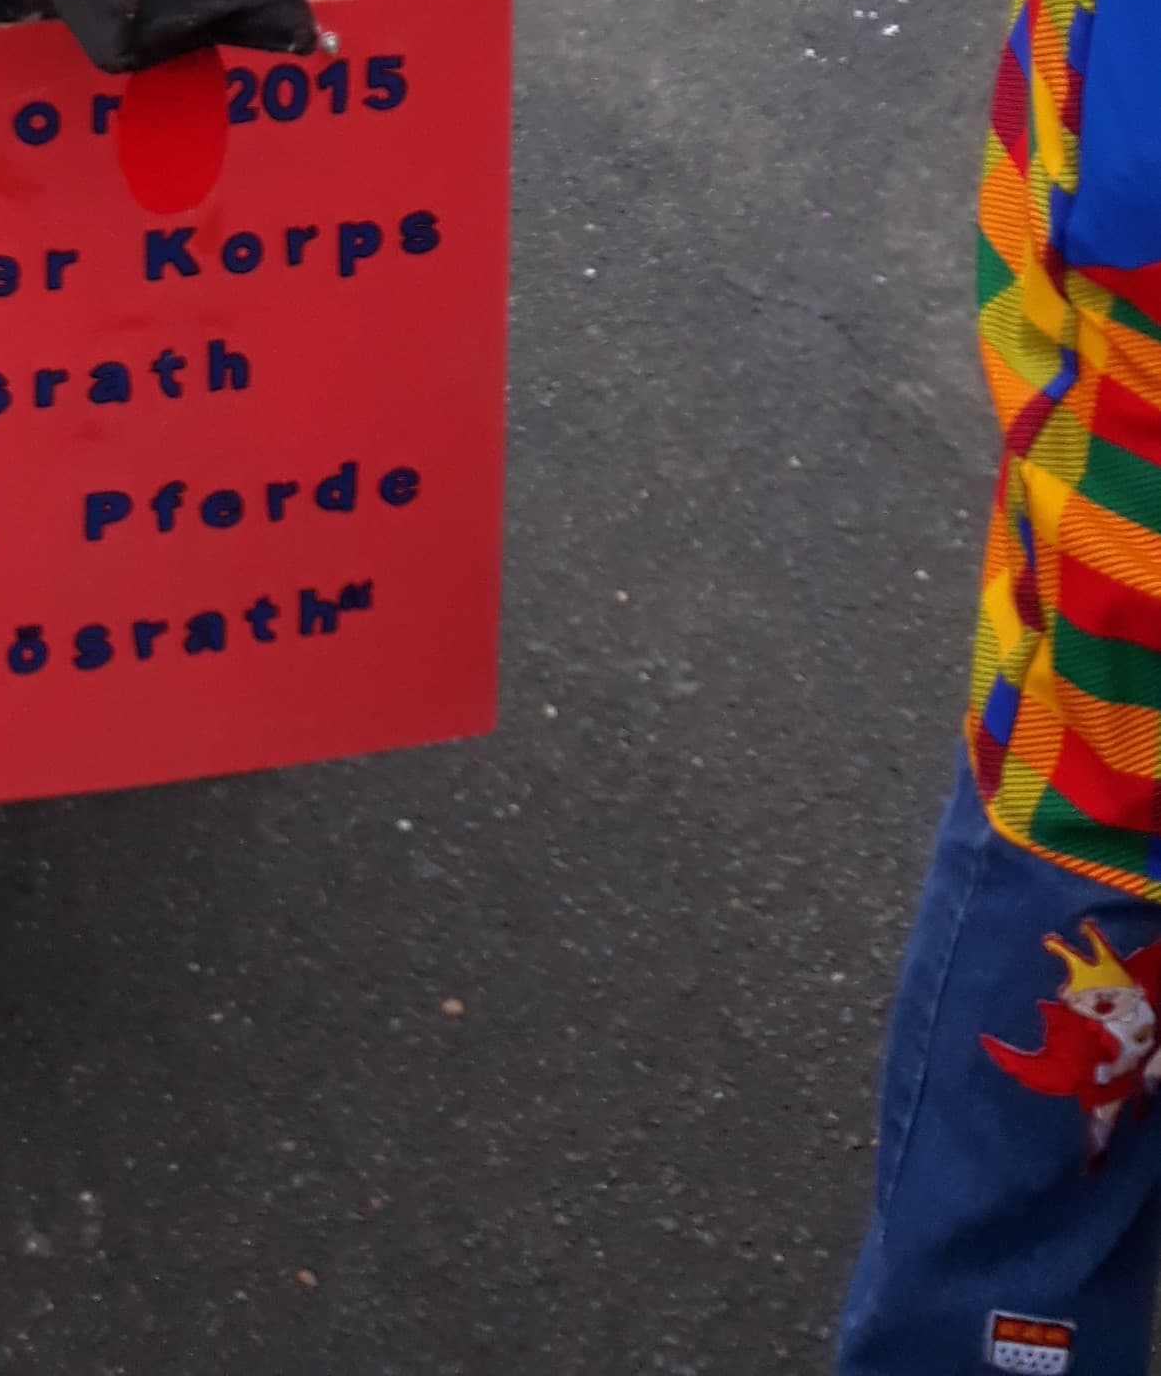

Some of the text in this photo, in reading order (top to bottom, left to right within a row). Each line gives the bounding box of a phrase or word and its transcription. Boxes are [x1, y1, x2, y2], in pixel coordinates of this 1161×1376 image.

[227, 54, 407, 125] 2015
[144, 210, 441, 283] Korps
[83, 461, 419, 543] Pferde
